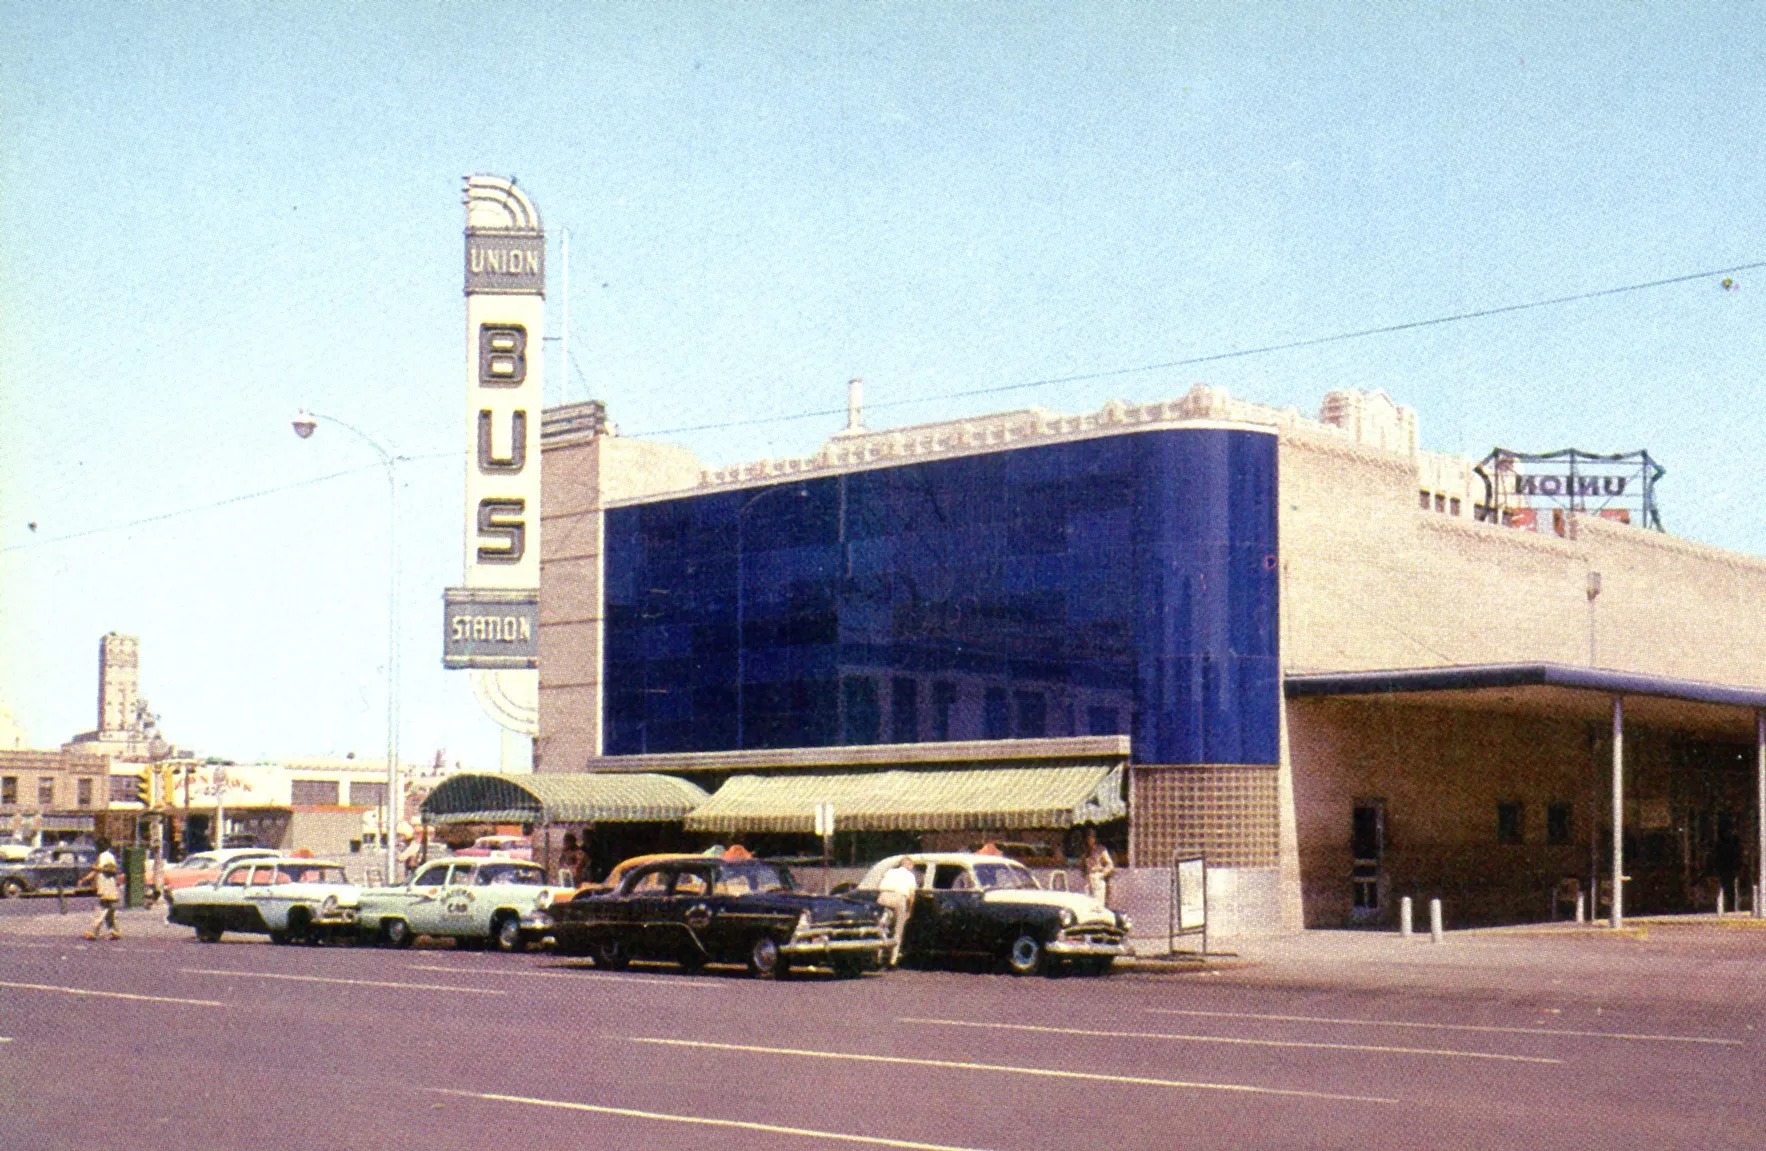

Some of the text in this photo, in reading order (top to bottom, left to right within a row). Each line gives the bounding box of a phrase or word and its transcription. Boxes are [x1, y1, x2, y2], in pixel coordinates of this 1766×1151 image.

[469, 247, 538, 273] UNION
[477, 323, 527, 565] BUS
[451, 615, 530, 640] STATION
